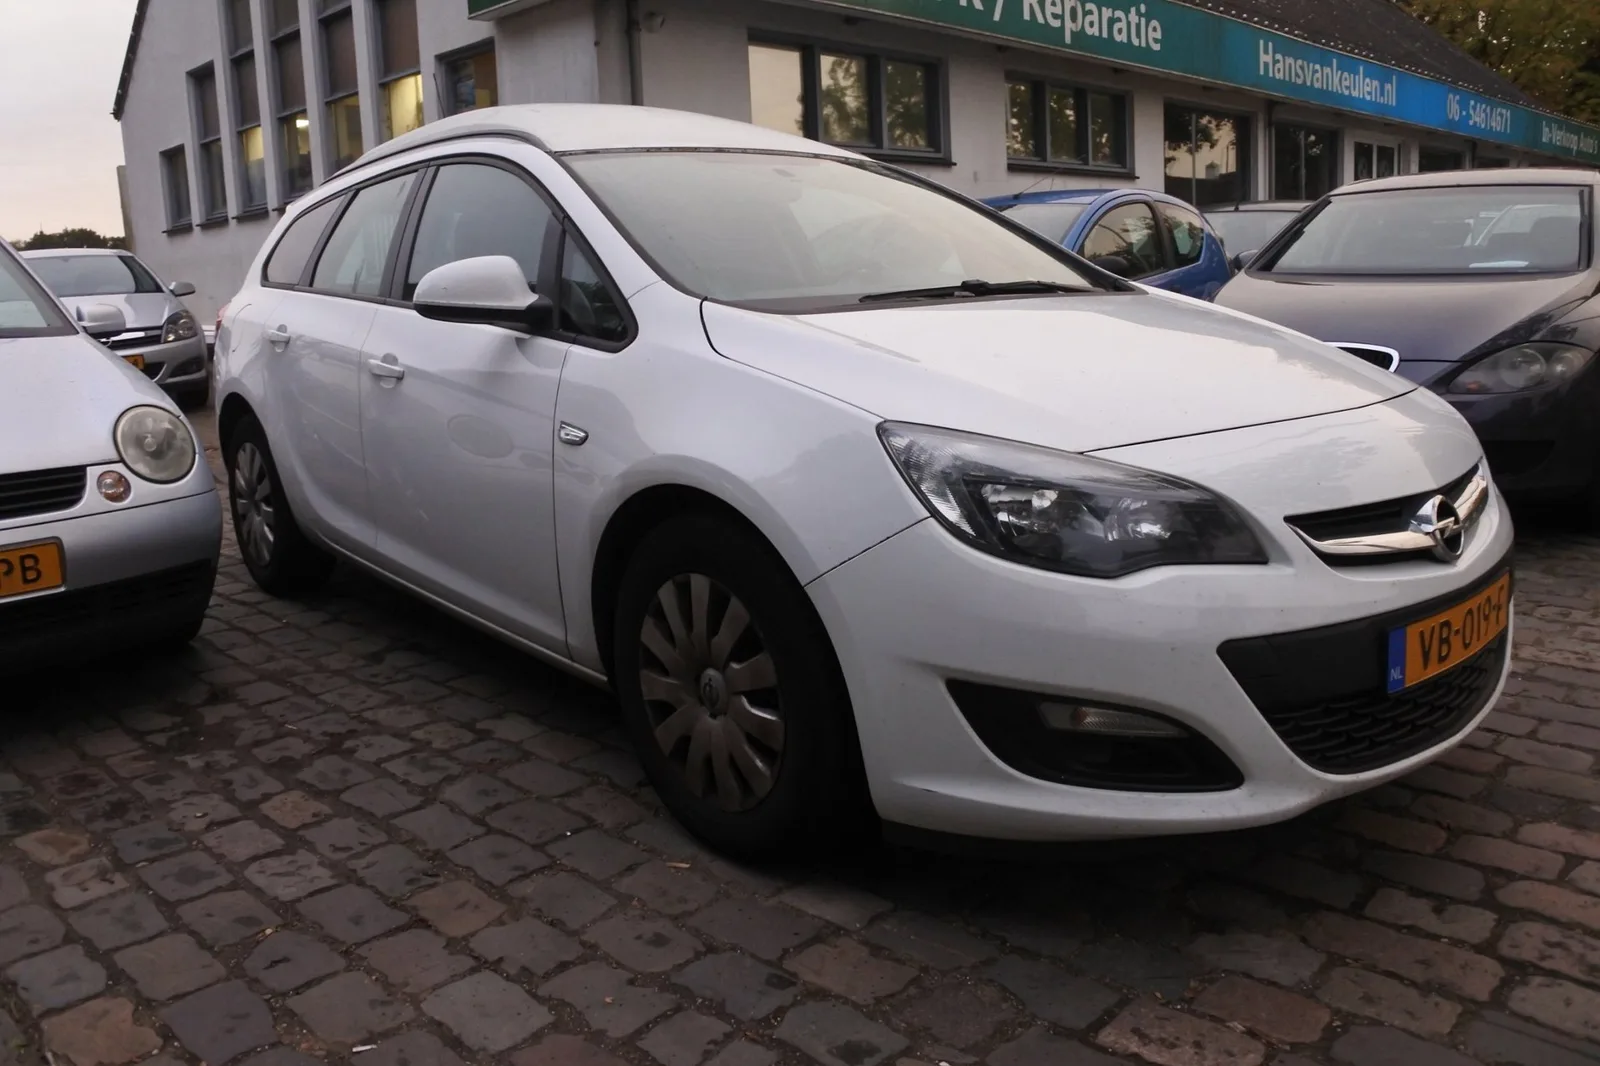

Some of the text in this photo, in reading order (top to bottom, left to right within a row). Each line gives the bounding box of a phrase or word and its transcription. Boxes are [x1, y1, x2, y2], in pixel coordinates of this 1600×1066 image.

[1259, 39, 1396, 107] Hansvankeulen.nl
[1447, 93, 1460, 122] 06
[1468, 99, 1511, 134] 54614671
[1390, 667, 1403, 681] NL
